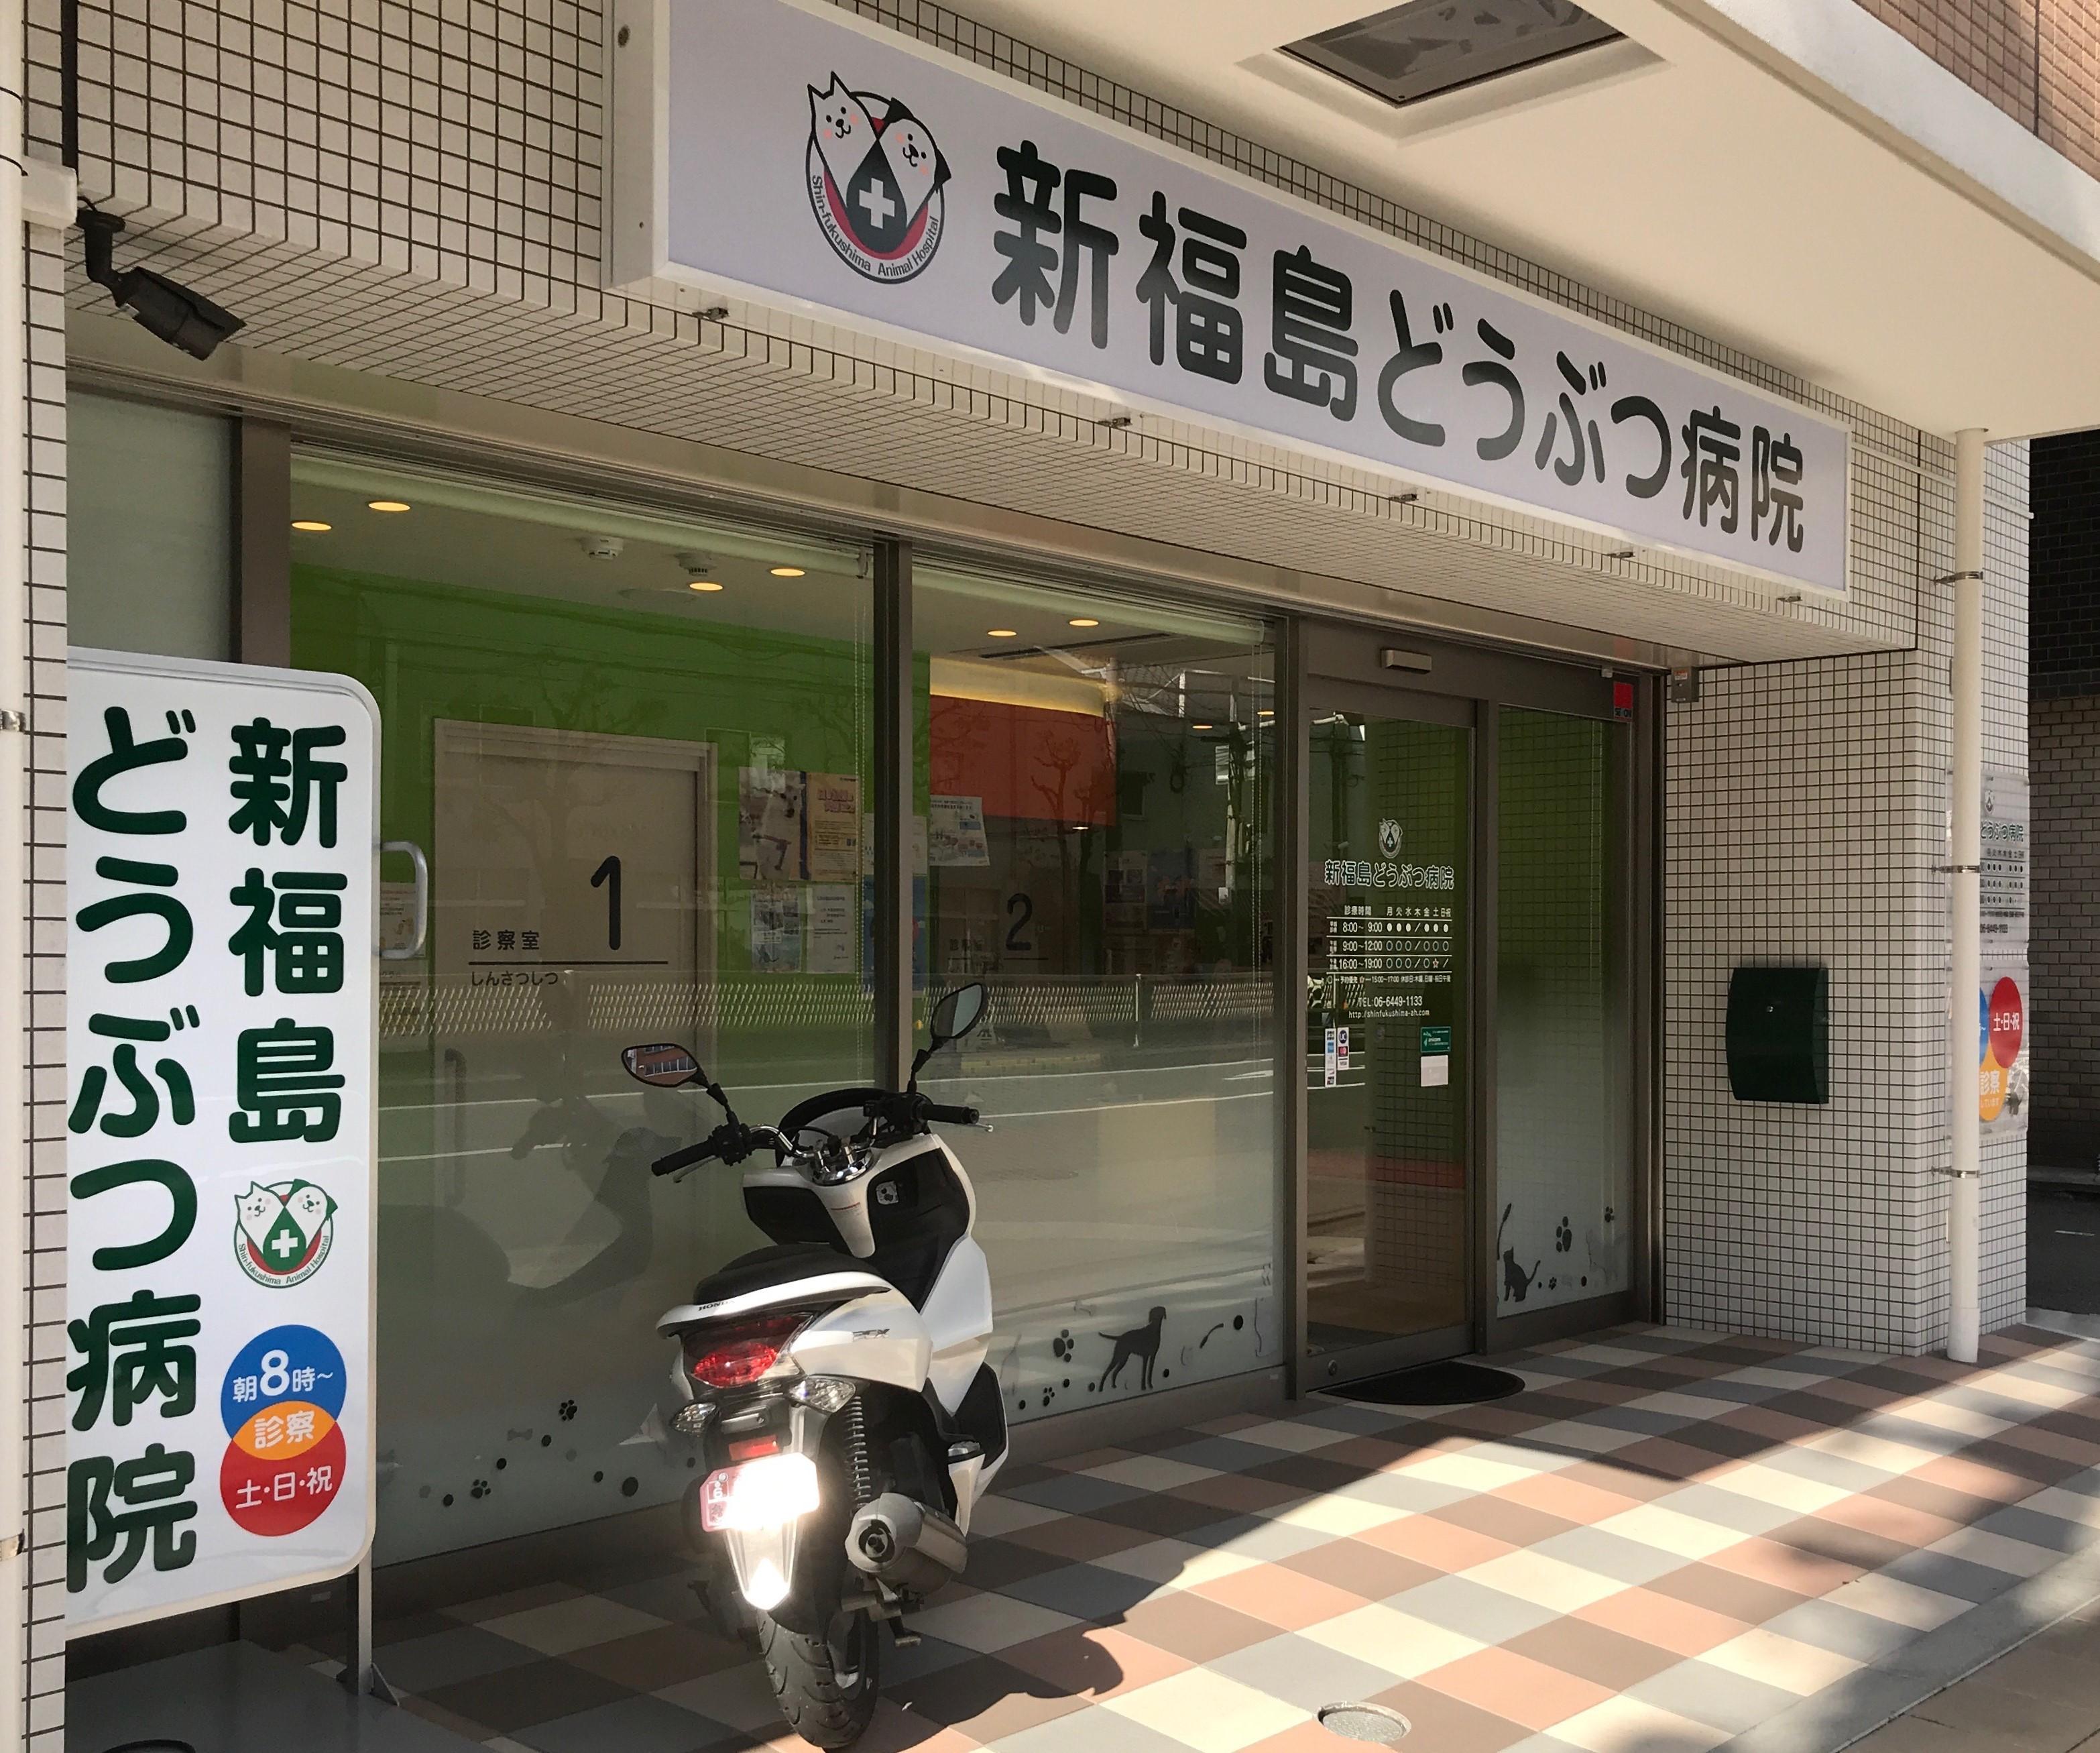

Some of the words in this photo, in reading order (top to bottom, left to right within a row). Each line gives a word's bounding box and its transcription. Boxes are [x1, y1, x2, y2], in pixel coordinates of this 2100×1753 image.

[812, 174, 872, 271] Shin-fukushima
[878, 258, 913, 277] Animal
[913, 217, 939, 267] Hospital
[992, 140, 1804, 553] 新福島どうぶつ病院
[591, 856, 621, 950] 1
[1325, 859, 1454, 889] 新福島どうぶつ病院
[228, 716, 348, 1144] 新福島
[472, 929, 540, 950] 診察室
[1007, 893, 1033, 951] 2
[471, 970, 559, 986] しんさつしつ
[67, 705, 201, 1593] どうぶつ病院
[238, 1243, 282, 1284] Shin-fukushima
[286, 1265, 310, 1284] Animal
[310, 1235, 329, 1267] Hospital
[253, 1410, 315, 1449] 診察
